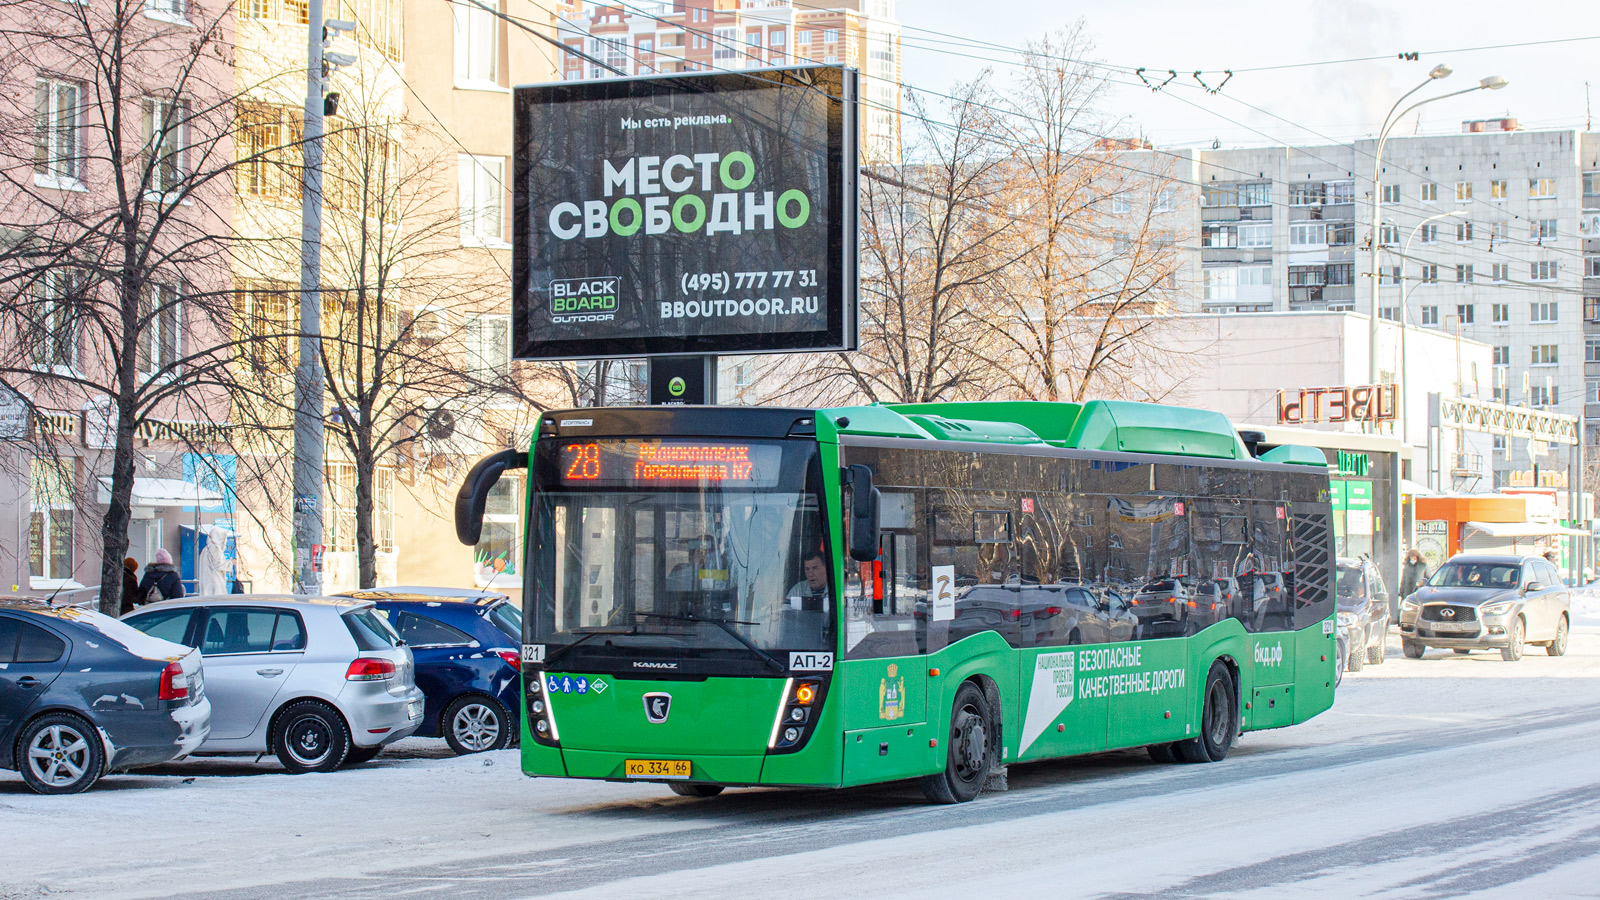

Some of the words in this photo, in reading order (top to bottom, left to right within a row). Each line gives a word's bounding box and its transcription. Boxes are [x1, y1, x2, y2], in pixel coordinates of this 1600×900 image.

[621, 117, 641, 129] Мы
[644, 119, 671, 128] есть
[674, 114, 732, 130] реклама.
[603, 151, 755, 197] МЕСТО
[549, 189, 810, 240] СВОБОДНО
[554, 280, 616, 297] BLACK
[681, 271, 730, 295] (495)
[734, 271, 768, 289] 777
[772, 270, 794, 288] 77
[798, 269, 818, 287] 31
[553, 296, 616, 312] BOARD
[660, 296, 819, 319] BBOUTDOOR.RU
[552, 314, 615, 324] OUTDOOR
[639, 443, 749, 461] Радиоколледж
[566, 443, 600, 479] 28
[635, 461, 729, 480] Горбольница
[1324, 621, 1332, 633] 321
[523, 646, 539, 661] 321
[792, 654, 831, 668] АП-2
[1037, 653, 1074, 671] НАЦИОНАЛЬНЫЕ
[1079, 645, 1142, 672] БЕЗОПАСНЫЕ
[1254, 641, 1283, 668] бкд.рф
[633, 661, 678, 669] KAMAZ
[1053, 669, 1074, 684] ПРОЕКТЫ
[1078, 671, 1151, 700] КАЧЕСТВЕННЫЕ
[1151, 668, 1185, 696] ДОРОГИ
[1056, 683, 1074, 699] РОССИИ
[648, 762, 670, 774] 334
[675, 761, 687, 771] 66
